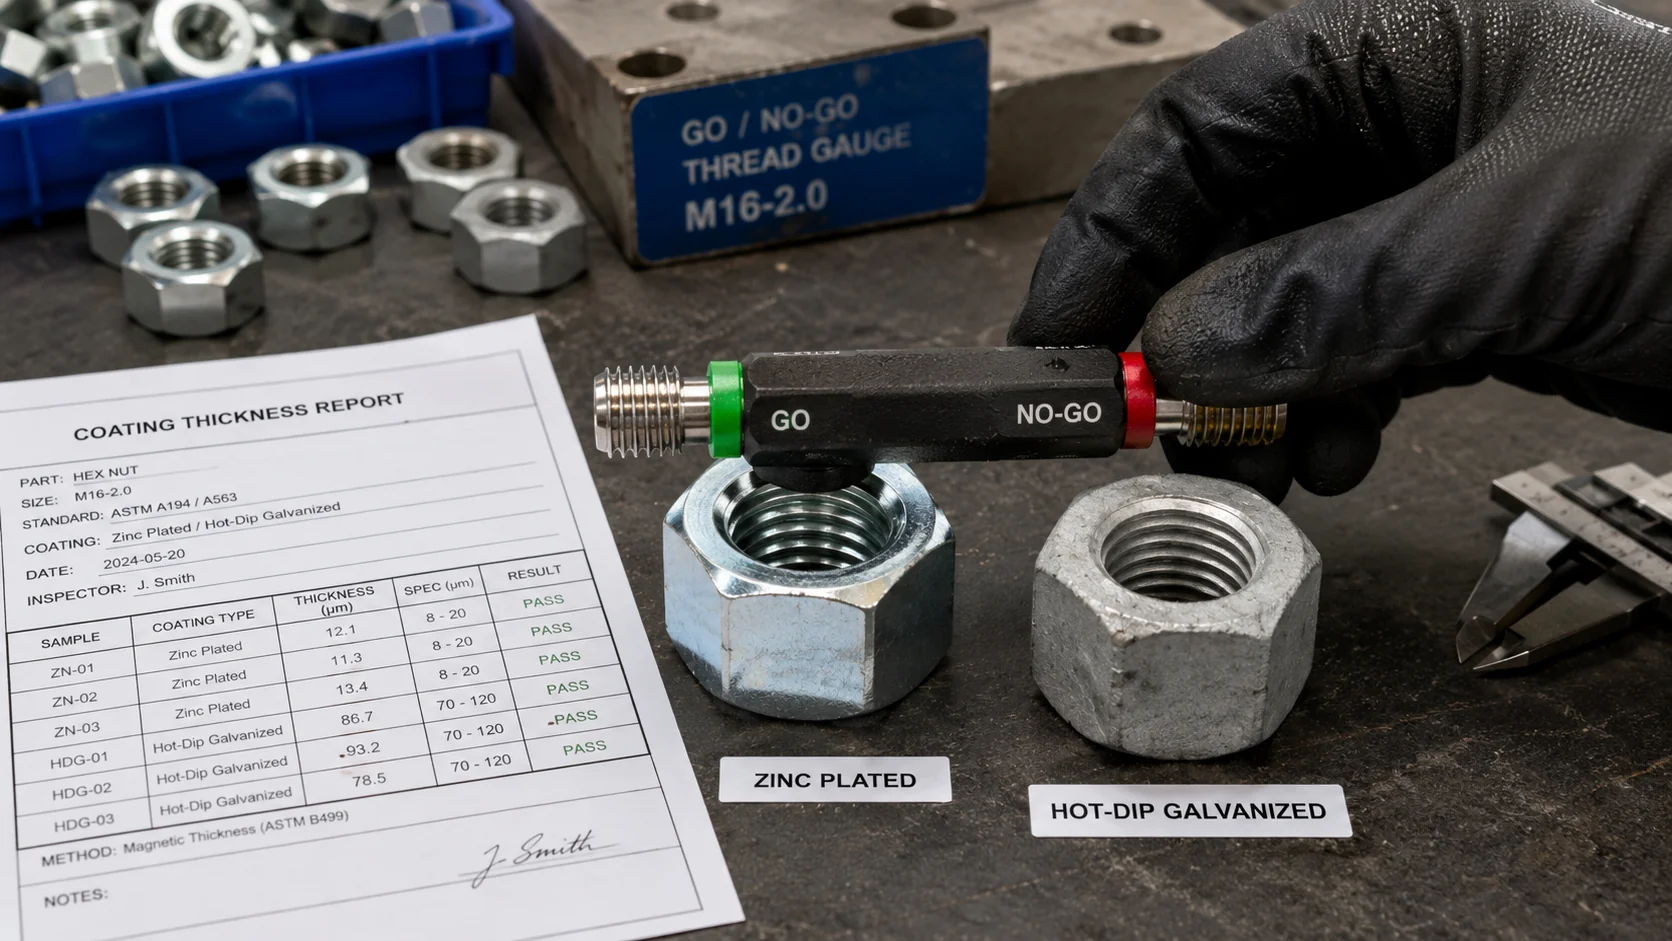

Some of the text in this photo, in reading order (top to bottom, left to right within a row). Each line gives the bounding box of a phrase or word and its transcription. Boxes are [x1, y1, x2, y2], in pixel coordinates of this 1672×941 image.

[681, 94, 859, 146] GO / NO-GO
[682, 122, 911, 185] THREAD GAUGE
[685, 179, 828, 232] M16-2.0
[73, 392, 405, 441] COATING THICKNESS REPORT
[771, 409, 810, 431] GO
[1017, 402, 1102, 425] NO-GO
[20, 466, 138, 488] PART: HEX NUT
[21, 486, 132, 508] SIZE: M16-2.0
[22, 492, 237, 529] STANDARD: ASTM A194 / A563
[24, 502, 341, 555] COATING: Zinc Plated / Hot-Dip Galvanized
[26, 548, 186, 580] DATE: 2024-05-20
[508, 565, 562, 581] RESULT
[27, 572, 195, 606] INSPECTOR: J. Smith
[294, 586, 375, 606] THICKNESS
[404, 582, 441, 596] SPEC
[523, 595, 565, 609] PASS
[152, 609, 255, 633] COATING TYPE
[426, 613, 434, 623] 8
[451, 608, 467, 620] 20
[326, 625, 356, 638] 12.1
[531, 622, 573, 637] PASS
[41, 632, 100, 648] SAMPLE
[432, 640, 440, 651] 8
[456, 636, 473, 648] 20
[169, 641, 242, 660] Zinc Plated
[331, 653, 363, 666] 11.3
[539, 651, 581, 665] PASS
[51, 664, 94, 678] ZN-01
[172, 670, 247, 690] Zinc Plated
[439, 669, 448, 680] 8
[463, 665, 480, 677] 20
[336, 682, 368, 695] 13.4
[547, 680, 589, 695] PASS
[52, 692, 98, 708] ZN-02
[437, 698, 455, 711] 70
[470, 693, 497, 707] 120
[175, 699, 250, 720] Zinc Plated
[341, 711, 373, 726] 86.7
[554, 709, 598, 725] PASS
[54, 721, 100, 738] ZN-03
[443, 728, 462, 742] 70
[477, 723, 504, 737] 120
[153, 725, 283, 754] Hot-Dip Galvanized
[563, 740, 607, 756] PASS
[346, 742, 380, 757] 93.2
[50, 752, 108, 769] HDG-01
[451, 760, 470, 773] 70
[485, 754, 512, 769] 120
[156, 756, 288, 785] Hot-Dip Galvanized
[352, 773, 386, 787] 78.5
[754, 772, 917, 789] ZINC PLATED
[52, 782, 112, 800] HDG-02
[160, 787, 292, 816] Hot-Dip Galvanized
[1051, 802, 1327, 820] HOT-DIP GALVANIZED
[54, 814, 115, 832] HDG-03
[41, 810, 349, 867] METHOD: Magnetic Thickness (ASTM B499)
[44, 888, 108, 908] NOTES:
